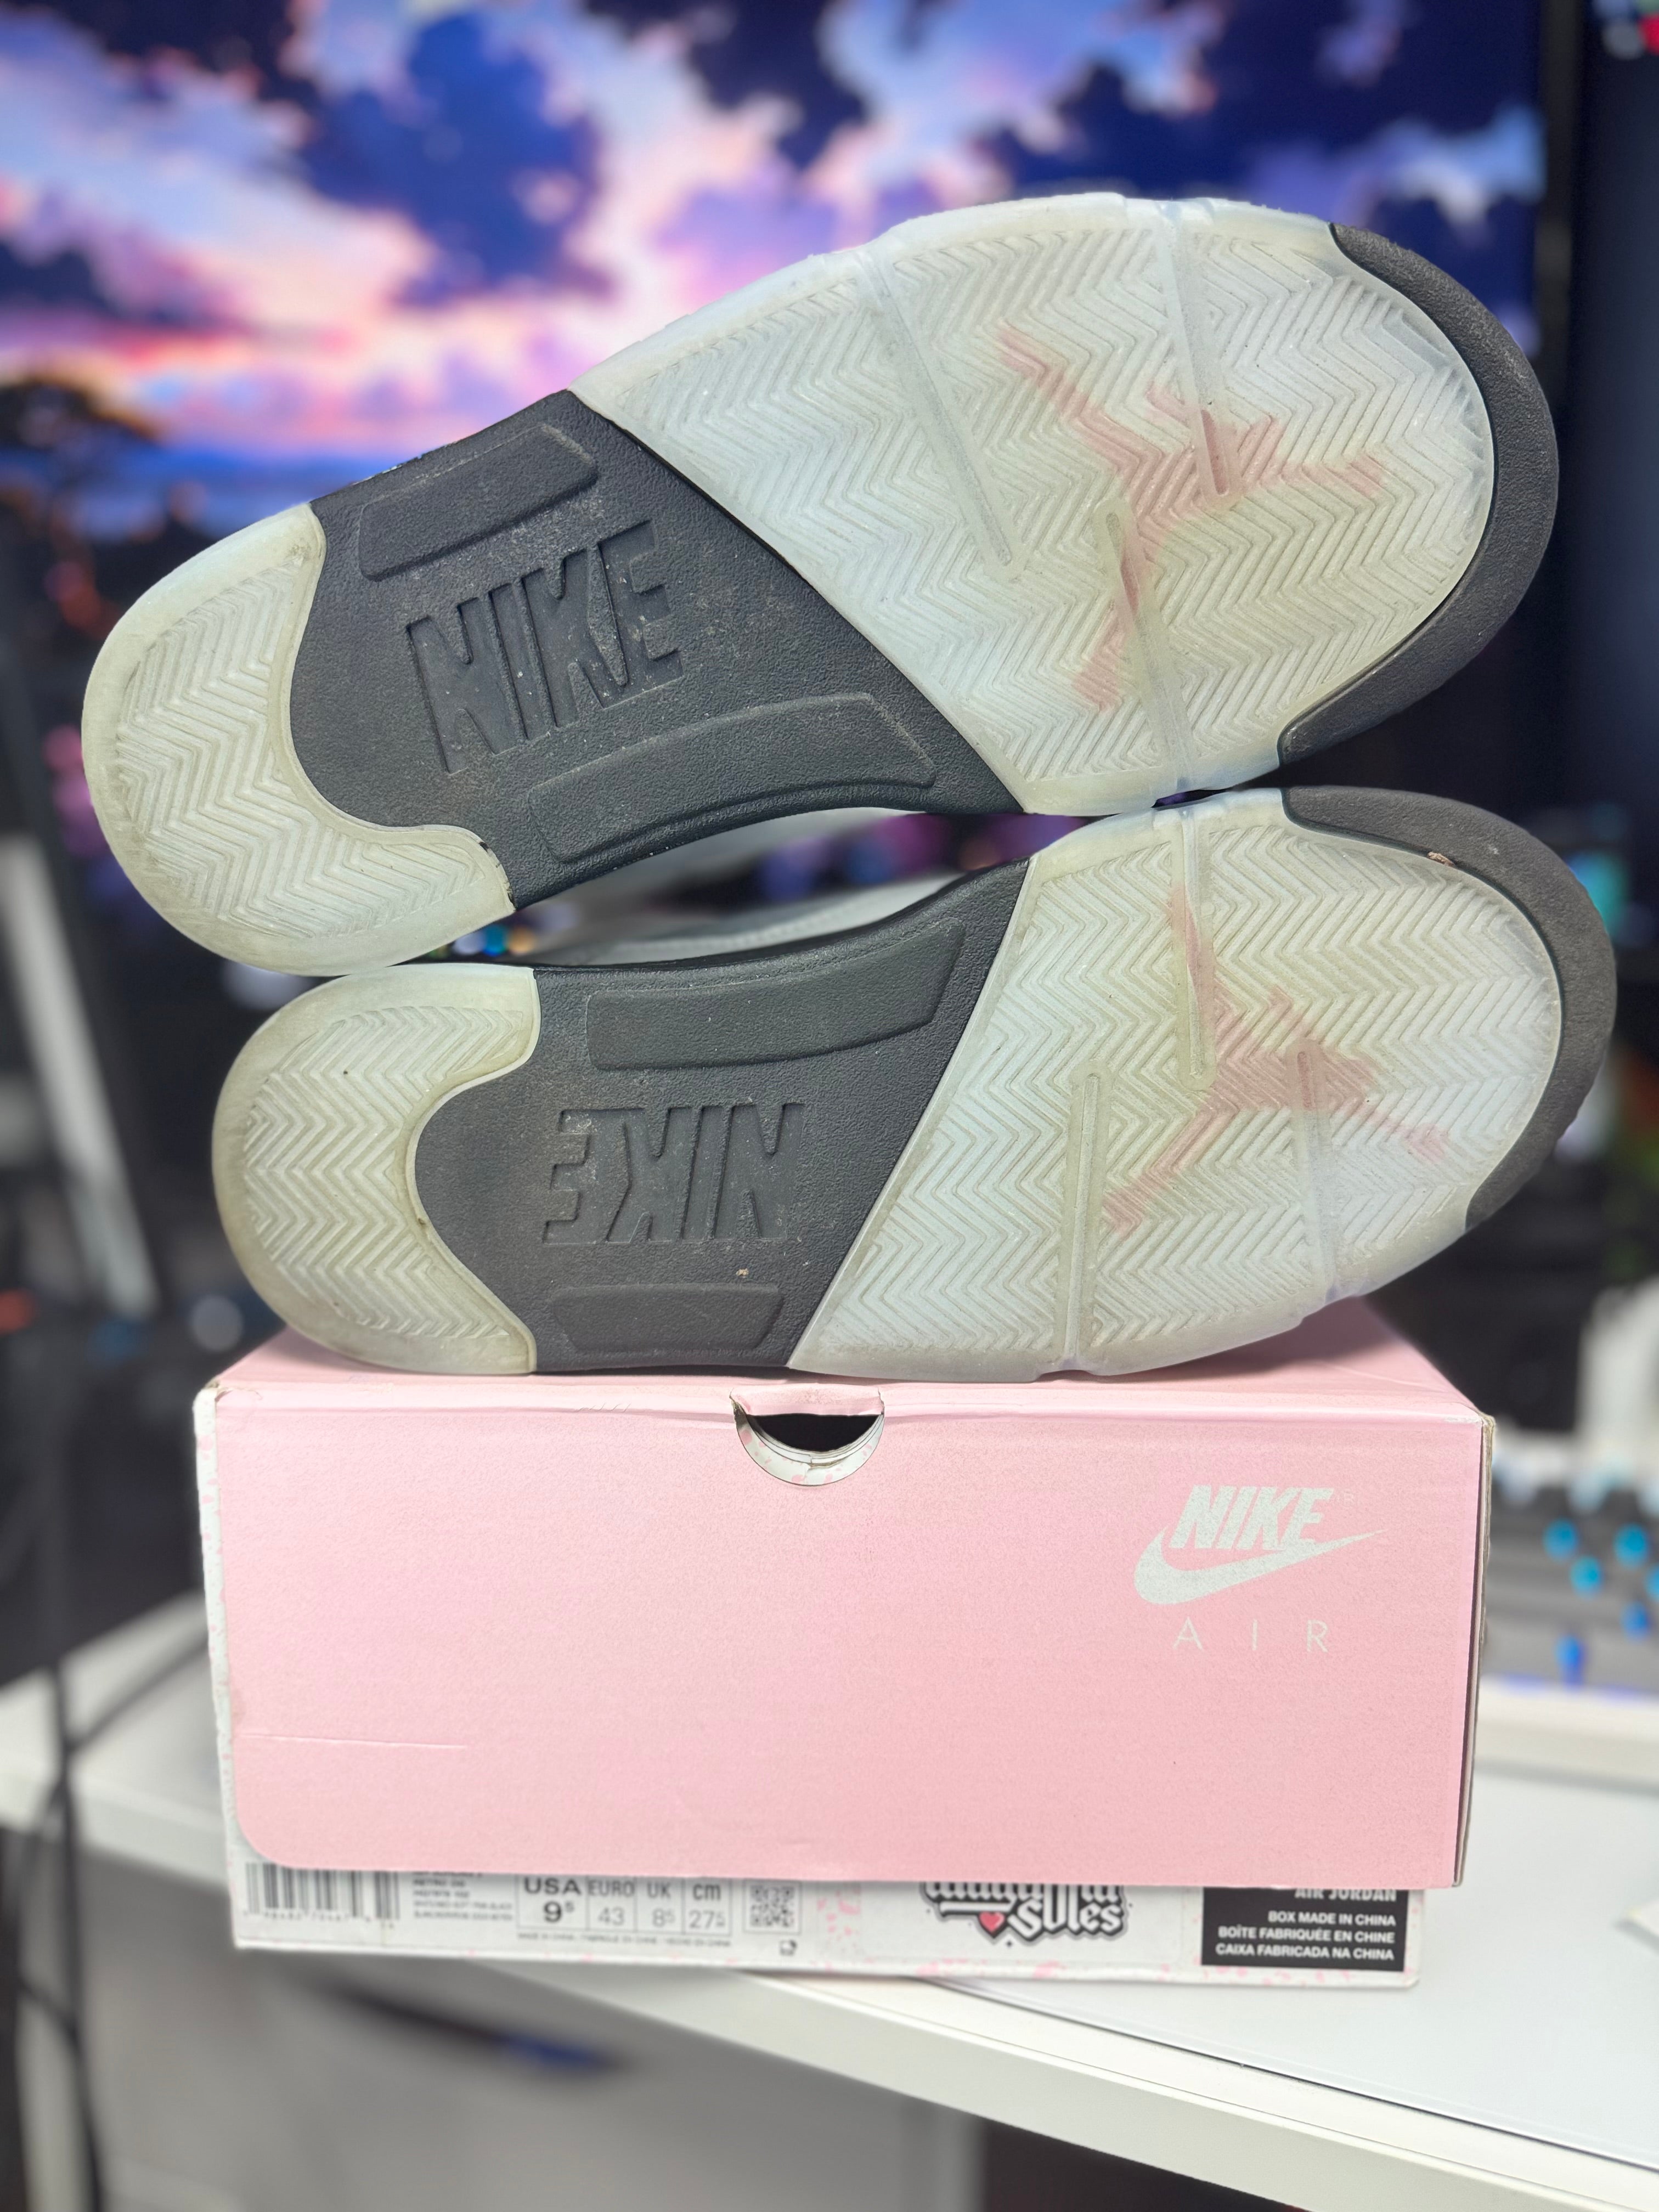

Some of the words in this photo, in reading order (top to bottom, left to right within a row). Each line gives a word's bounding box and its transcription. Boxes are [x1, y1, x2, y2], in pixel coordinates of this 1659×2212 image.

[406, 519, 684, 775] NIKE
[543, 1102, 805, 1244] NIKE
[1169, 1485, 1334, 1550] NIKE
[1172, 1617, 1329, 1652] AIR
[524, 1877, 582, 1895] USA
[588, 1880, 635, 1897] EURO
[647, 1881, 671, 1899] UK
[693, 1883, 721, 1900] cm
[1295, 1888, 1324, 1899] AIR
[1328, 1888, 1397, 1901] JORDAN
[598, 1906, 625, 1926] 43
[1268, 1911, 1296, 1923] BOX
[1298, 1912, 1336, 1924] MADE
[1339, 1914, 1352, 1925] IN
[1355, 1914, 1396, 1926] CHINA
[1218, 1925, 1256, 1939] BOÎTE
[1259, 1927, 1331, 1941] FABRIQUÉE
[1334, 1930, 1352, 1942] EN
[1355, 1931, 1395, 1944] CHINE
[1215, 1943, 1255, 1956] CAIXA
[1257, 1945, 1330, 1958] FABRICADA
[1332, 1947, 1351, 1959] NA
[1353, 1948, 1395, 1960] CHINA
